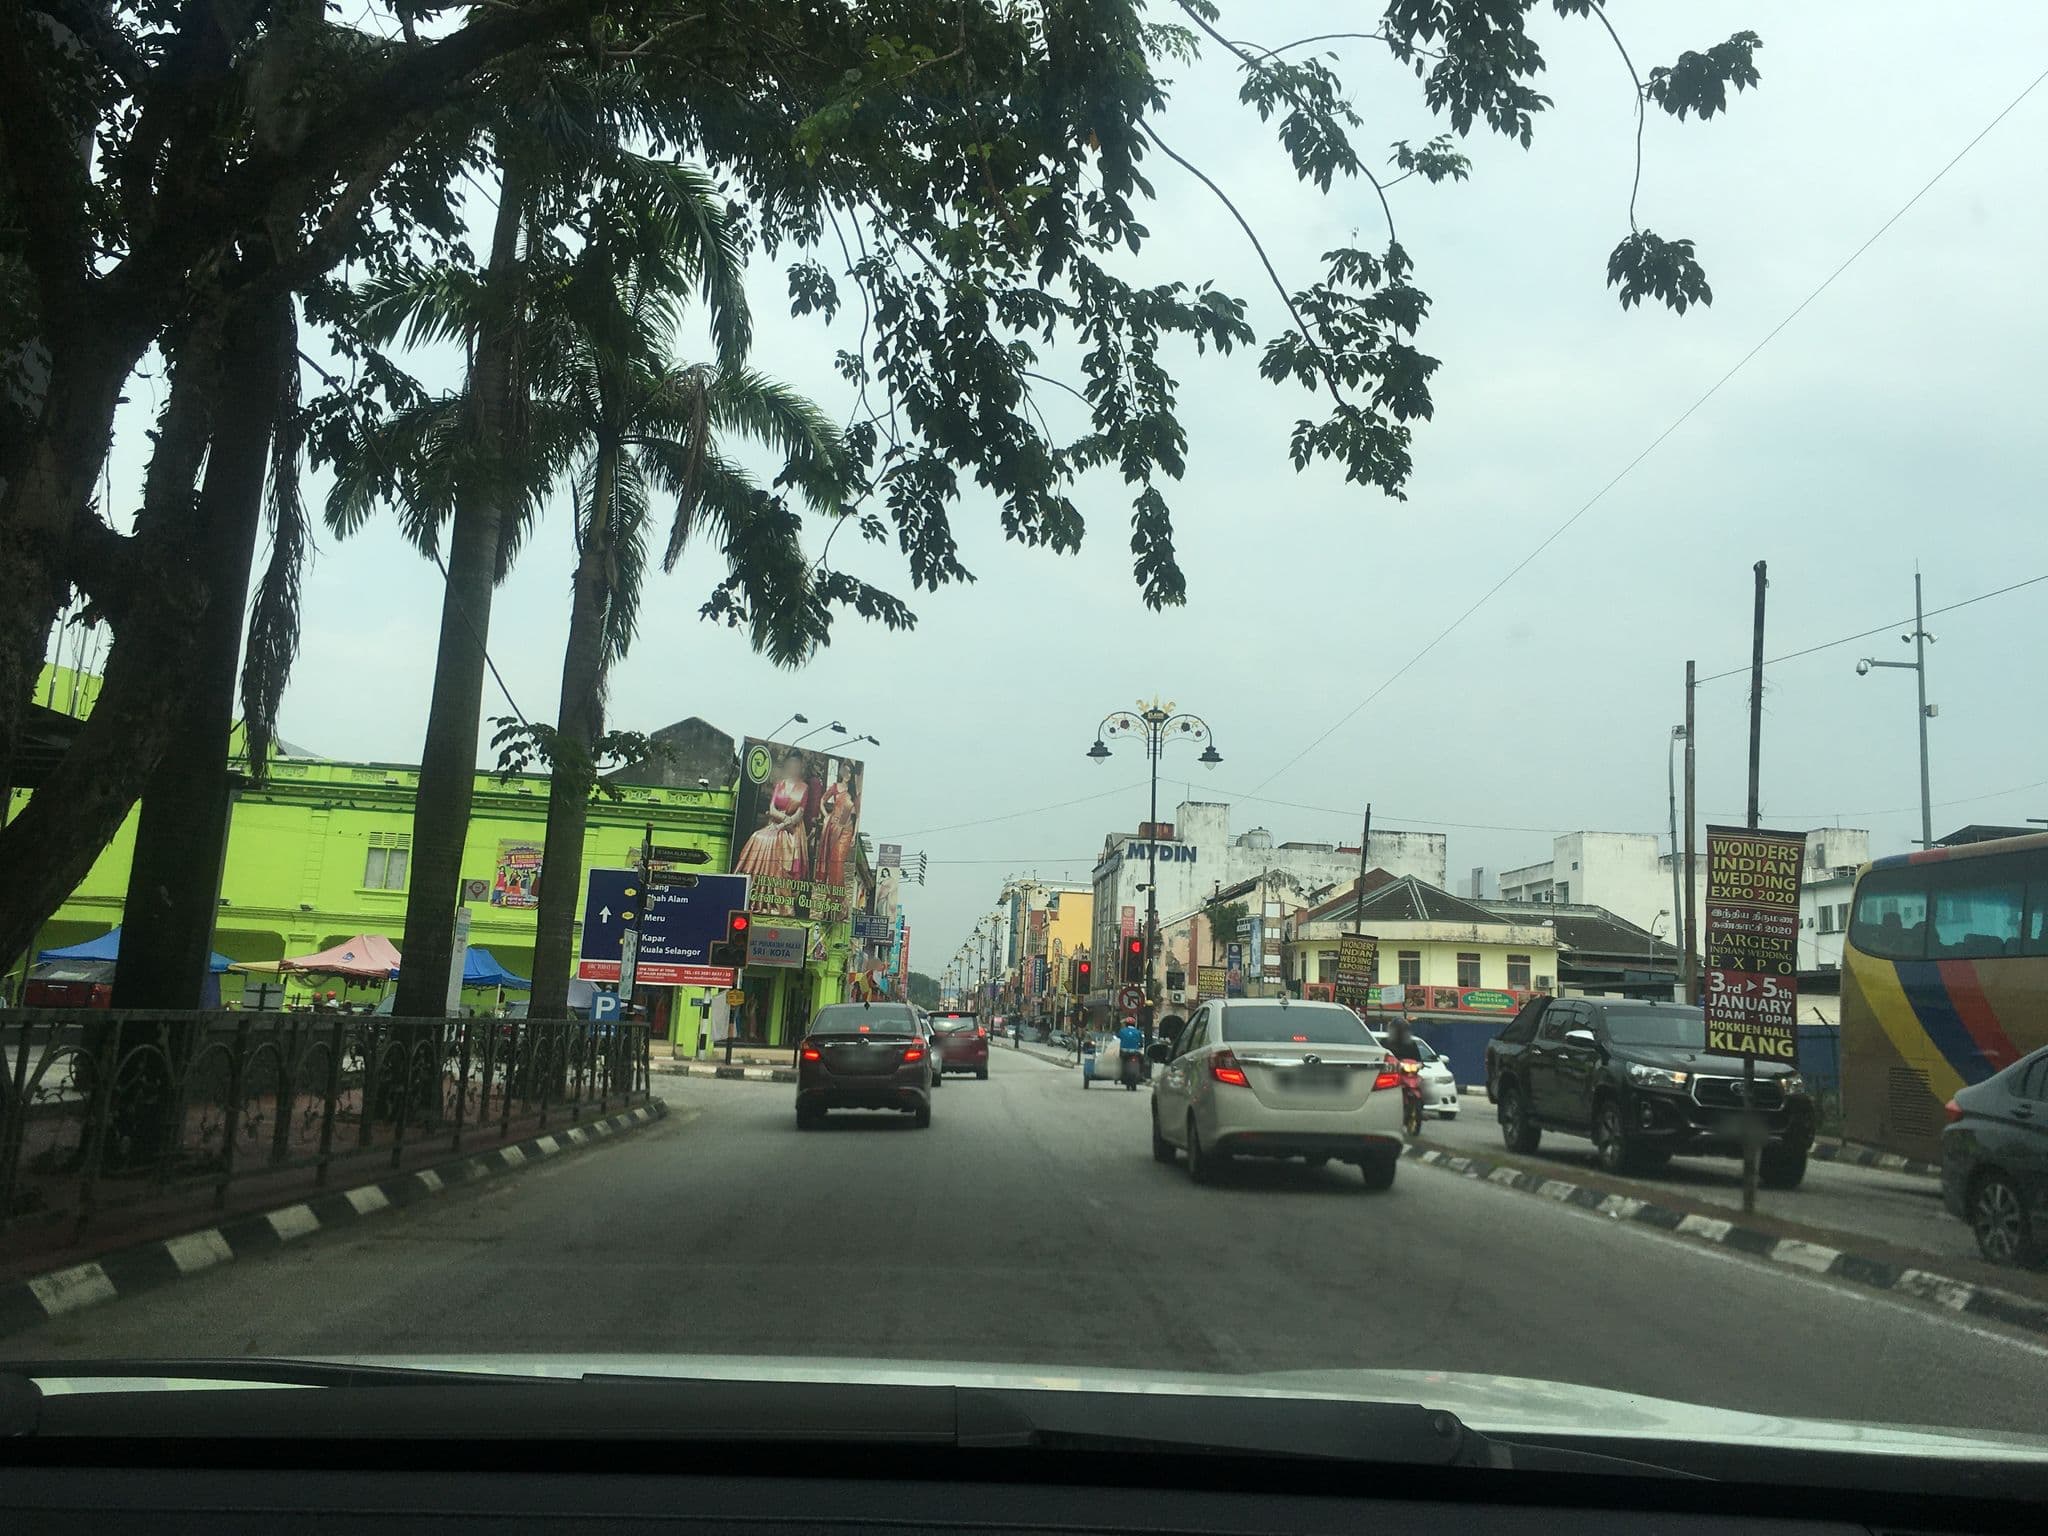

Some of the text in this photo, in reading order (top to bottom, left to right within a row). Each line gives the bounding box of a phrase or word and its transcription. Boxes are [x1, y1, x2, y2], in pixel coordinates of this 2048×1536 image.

[1126, 843, 1197, 863] MYDIN
[1712, 840, 1799, 861] WONDERS
[1713, 857, 1796, 875] INDIAN
[1712, 871, 1796, 890] WEDDING
[667, 895, 688, 903] Alam
[1711, 886, 1795, 903] EXPO 2020
[644, 914, 666, 922] Meru
[642, 934, 666, 943] Kapar
[1765, 925, 1792, 935] 2020
[1711, 932, 1792, 951] LARGEST
[640, 945, 701, 957] Kuala Selangor
[752, 947, 791, 957] SRI KOTA
[1710, 946, 1793, 961] INDIAN WEDDING
[1711, 955, 1792, 974] EXPO
[1710, 972, 1792, 999] 3rd 5th
[595, 997, 616, 1020] P
[1709, 993, 1792, 1015] JANUARY
[1710, 1008, 1745, 1020] 10AM
[1759, 1013, 1792, 1025] 10PM
[1710, 1020, 1792, 1038] HOKKIEN HALL
[1710, 1031, 1794, 1057] KLANG
